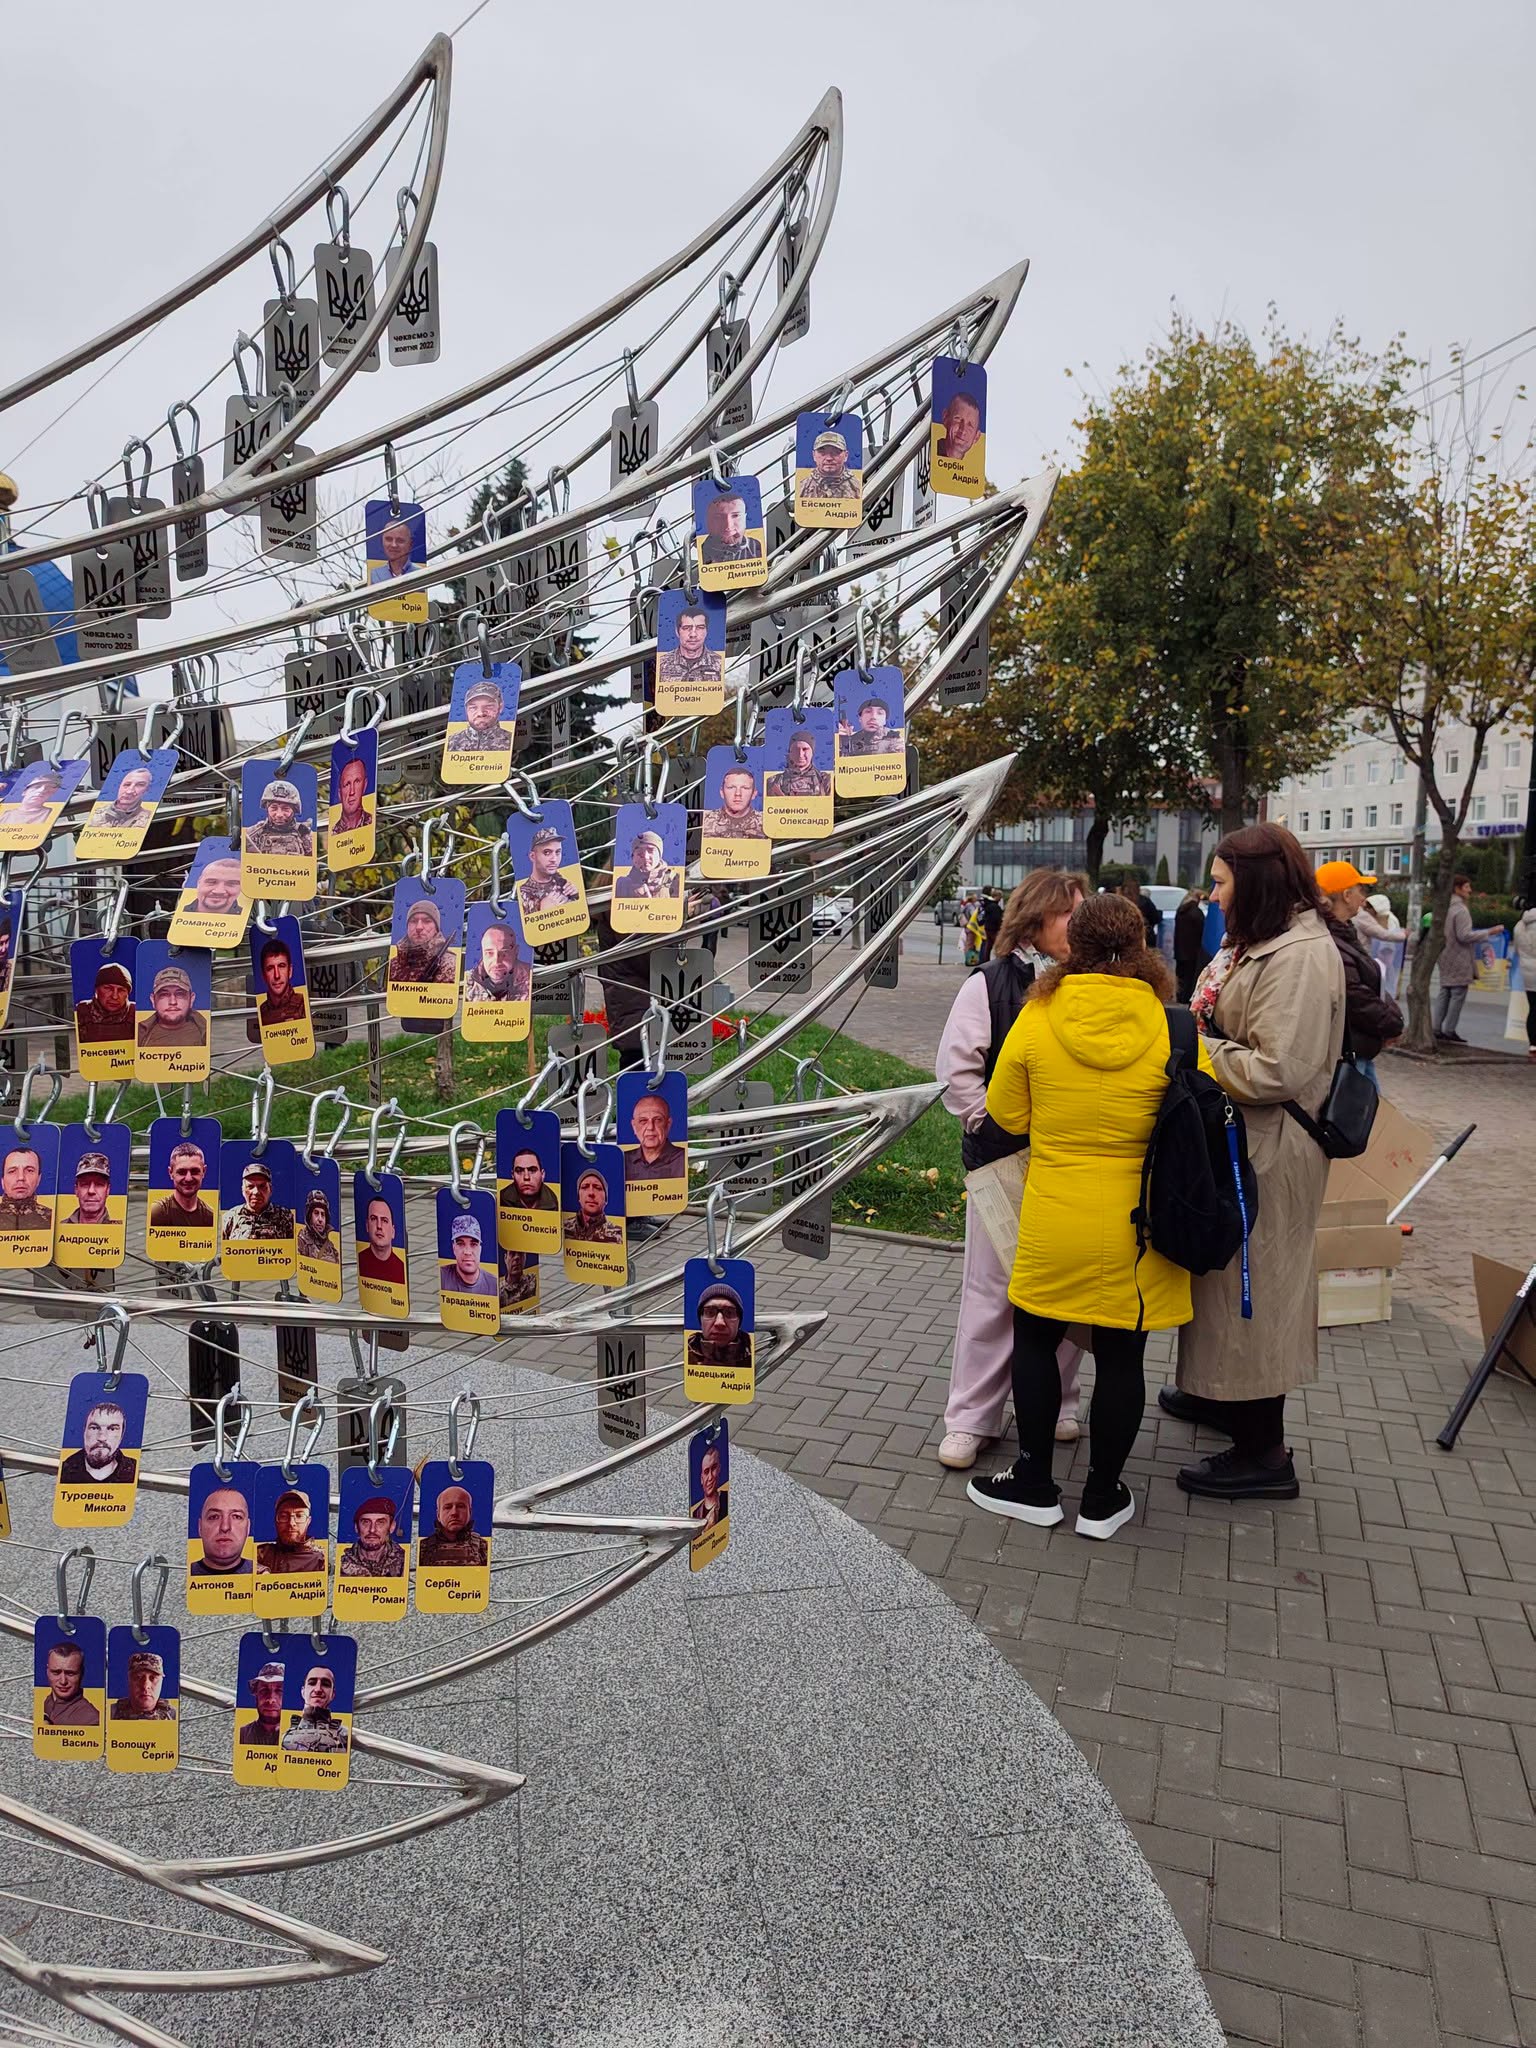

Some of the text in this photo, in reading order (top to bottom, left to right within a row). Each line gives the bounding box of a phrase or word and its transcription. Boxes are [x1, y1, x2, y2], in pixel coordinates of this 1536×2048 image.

[394, 332, 427, 341] чекаємо
[419, 341, 434, 350] 2022
[937, 458, 965, 472] Сербін
[952, 472, 979, 486] Андрій
[801, 500, 842, 509] Ейсмонт
[825, 509, 858, 520] Андрій
[295, 541, 311, 551] 2022
[700, 559, 763, 575] Островський
[727, 568, 767, 580] Дмитрій
[401, 603, 422, 613] Юрій
[83, 631, 124, 640] чекаємо
[84, 642, 133, 650] лютого 2025
[657, 684, 723, 695] Добровінський
[674, 695, 701, 703] Роман
[450, 754, 485, 764] Юрдига
[468, 762, 503, 772] Євгеній
[838, 763, 902, 774] Мірошніченко
[874, 773, 903, 782] Роман
[767, 806, 809, 815] Семенюк
[779, 816, 829, 827] Олександр
[12, 833, 40, 841] Сергій
[82, 830, 124, 840] Лук'янчук
[116, 839, 138, 849] Юрій
[336, 837, 354, 848] Савін
[349, 845, 366, 856] Юрій
[705, 847, 734, 858] Санду
[724, 857, 760, 869] Дмитро
[246, 864, 311, 878] Звольський
[258, 877, 297, 887] Руслан
[617, 902, 650, 913] Ляшук
[524, 908, 565, 925] Резенков
[648, 911, 678, 922] Євген
[175, 917, 227, 929] Романько
[538, 912, 587, 933] Олександр
[204, 928, 239, 939] Сергій
[391, 984, 429, 994] Михнюк
[419, 995, 454, 1005] Микола
[467, 1007, 504, 1017] Дейнека
[493, 1016, 525, 1027] Андрій
[290, 1036, 309, 1047] Олег
[80, 1047, 126, 1058] Ренсевич
[139, 1051, 182, 1060] Коструб
[110, 1057, 135, 1068] Дмит
[168, 1061, 206, 1072] Андрій
[652, 1192, 684, 1202] Роман
[500, 1210, 533, 1223] Волков
[149, 1227, 187, 1238] Руденко
[522, 1223, 558, 1236] Олексій
[58, 1233, 109, 1246] Андрощук
[179, 1238, 213, 1249] Віталій
[13, 1244, 49, 1255] Руслан
[88, 1245, 121, 1257] Сергій
[225, 1245, 284, 1257] Золотійчук
[565, 1247, 611, 1262] Корнійчук
[257, 1255, 292, 1266] Віктор
[299, 1261, 318, 1274] Заєць
[575, 1260, 625, 1274] Олександр
[309, 1275, 339, 1290] Анатолій
[361, 1280, 393, 1294] Чесноков
[390, 1296, 405, 1307] Іван
[441, 1294, 491, 1308] Тарадайник
[468, 1309, 497, 1322] Віктор
[687, 1367, 736, 1382] Медецький
[720, 1380, 752, 1392] Андрій
[603, 1410, 634, 1427] чекаємо
[60, 1490, 115, 1502] Туровець
[84, 1503, 126, 1513] Микола
[189, 1581, 235, 1591] Антонов
[255, 1579, 322, 1592] Гарбовський
[337, 1583, 388, 1596] Педченко
[424, 1578, 461, 1590] Сербін
[289, 1589, 326, 1601] Андрій
[371, 1594, 406, 1606] Роман
[447, 1589, 482, 1601] Сергій
[37, 1727, 86, 1738] Павленко
[62, 1738, 99, 1748] Василь
[110, 1740, 156, 1751] Волощук
[141, 1750, 175, 1762] Сергій
[283, 1755, 333, 1766] Павленко
[263, 1762, 278, 1773] Ар
[317, 1768, 342, 1780] Олег
